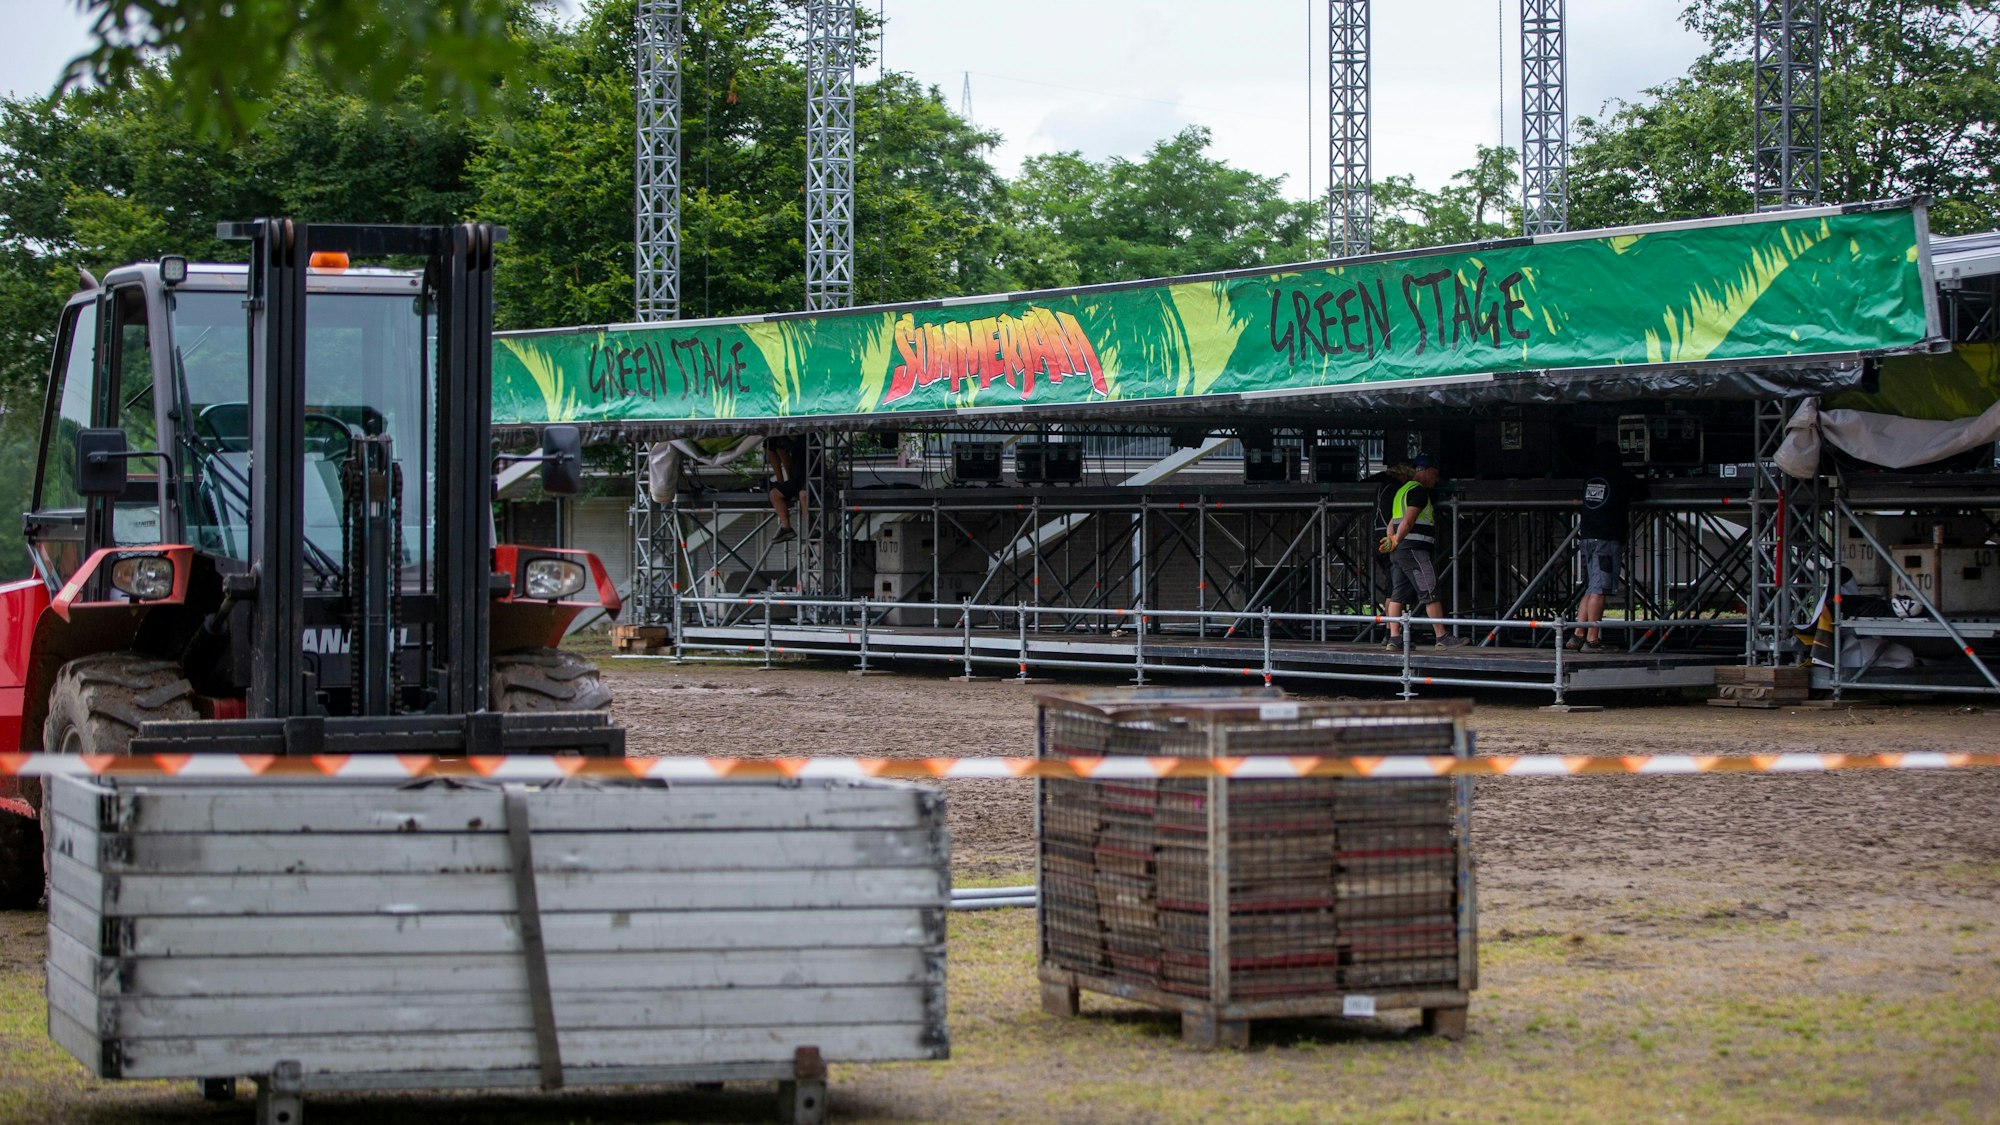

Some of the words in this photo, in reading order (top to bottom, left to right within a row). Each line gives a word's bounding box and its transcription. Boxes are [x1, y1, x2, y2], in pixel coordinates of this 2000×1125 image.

[1270, 278, 1392, 367] GREEN
[1402, 267, 1531, 357] STAGE
[589, 341, 667, 403] GREEN
[670, 337, 750, 400] STAGE
[882, 305, 1109, 405] SUMMERJAM
[889, 541, 898, 553] TO
[1860, 544, 1874, 560] TO
[1916, 573, 1932, 590] TO
